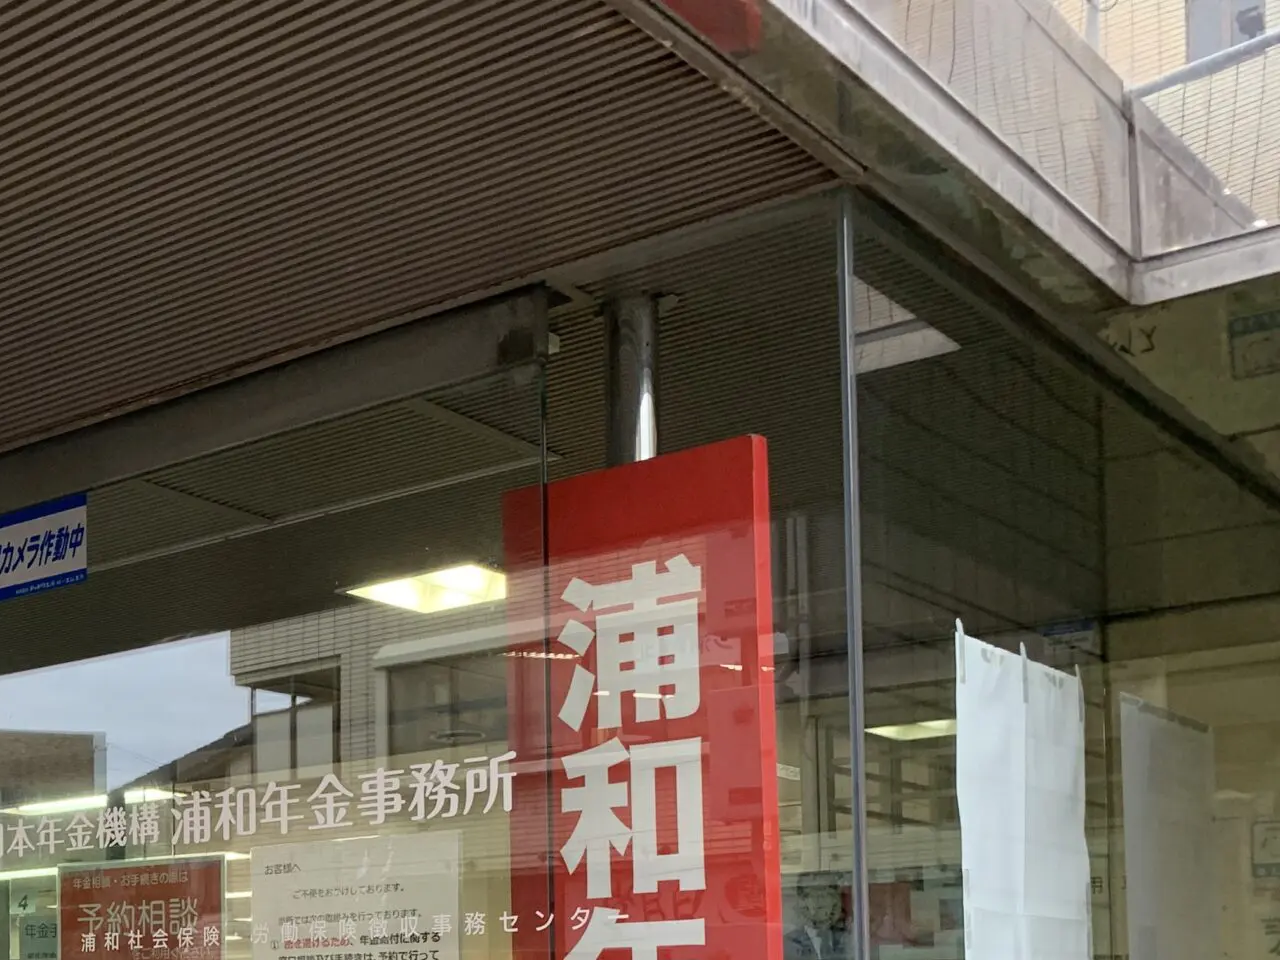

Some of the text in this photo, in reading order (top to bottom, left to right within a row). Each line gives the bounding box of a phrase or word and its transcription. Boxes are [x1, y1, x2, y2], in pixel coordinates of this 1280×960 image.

[171, 751, 517, 845] 浦和年金事務所
[77, 897, 198, 937] 予約相談
